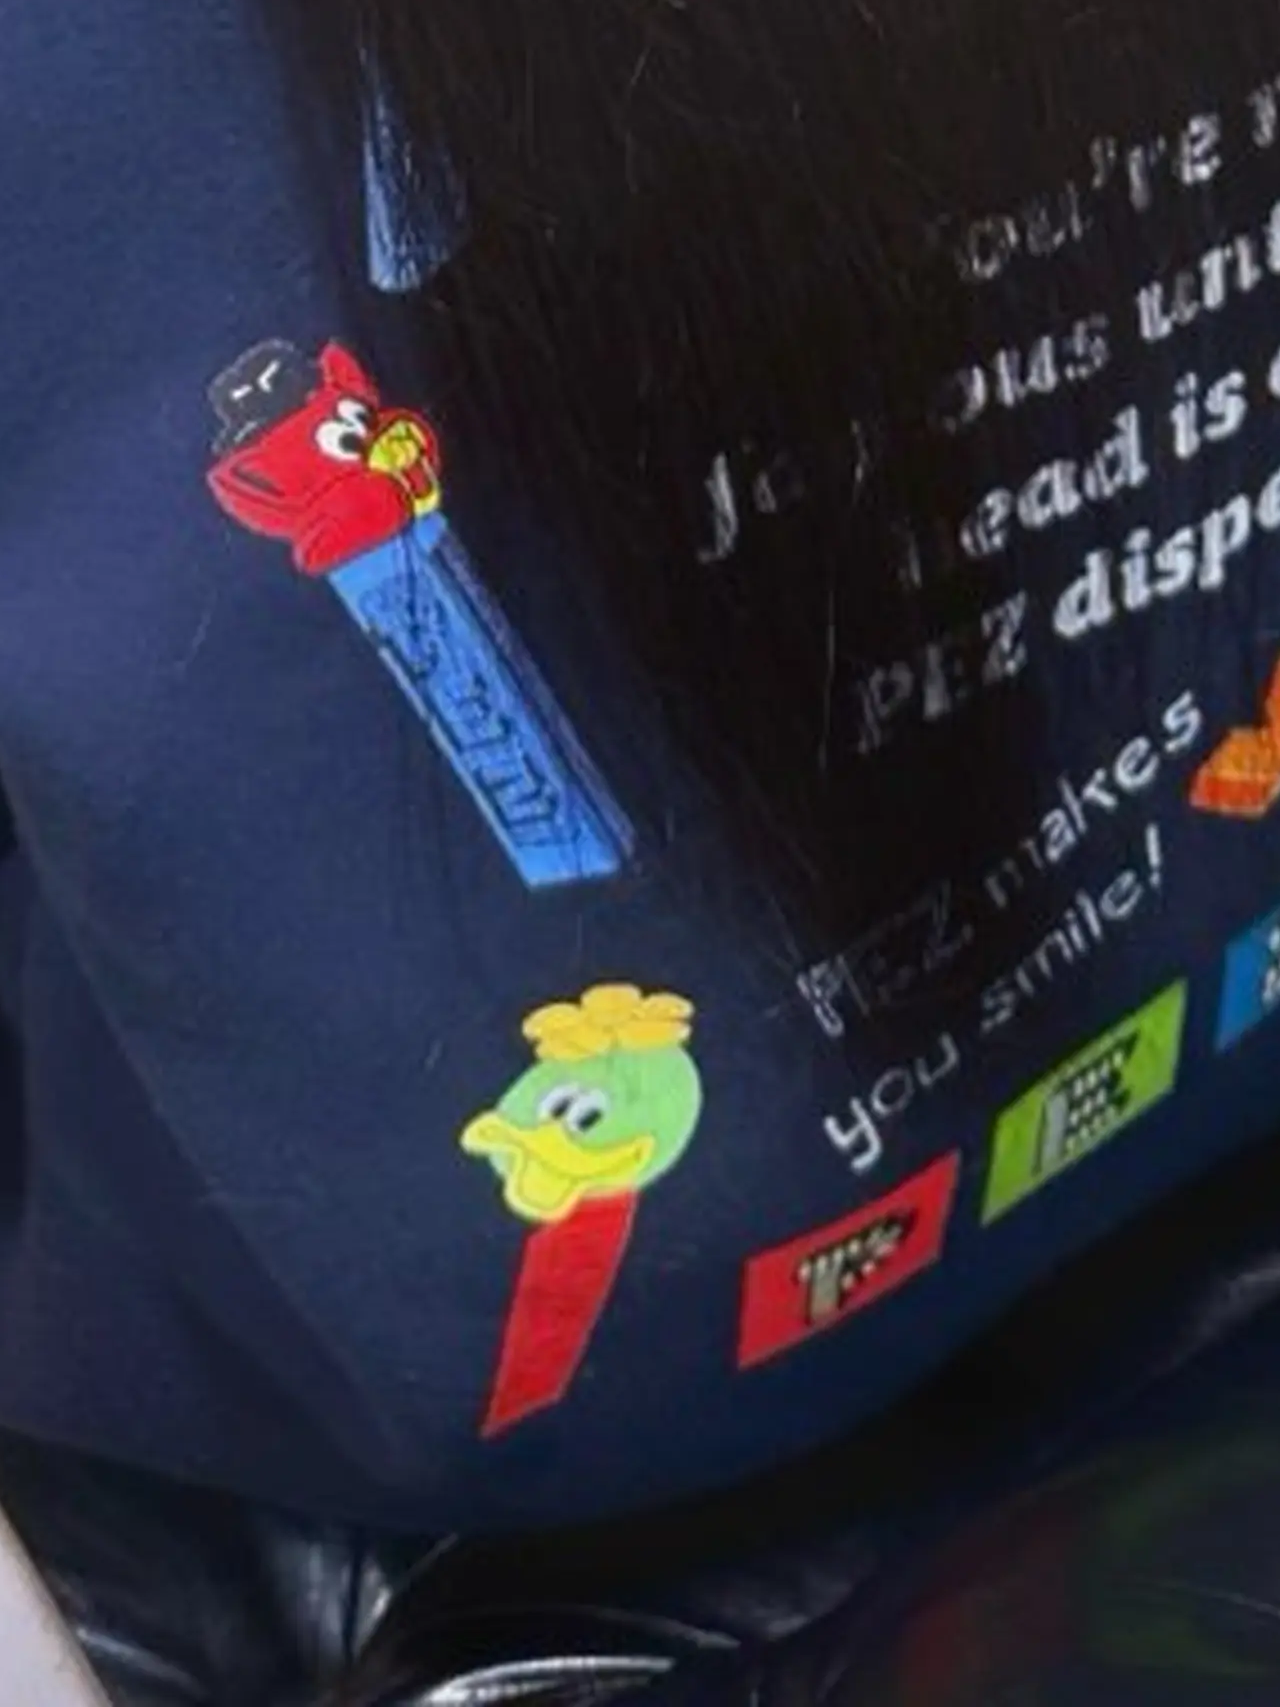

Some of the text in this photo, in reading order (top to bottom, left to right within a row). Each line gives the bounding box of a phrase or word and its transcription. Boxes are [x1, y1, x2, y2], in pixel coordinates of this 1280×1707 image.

[952, 110, 1222, 282] ou're
[894, 404, 1150, 589] ead
[1172, 370, 1246, 460] is
[983, 689, 1205, 910] makes
[823, 822, 1163, 1174] you smile!
